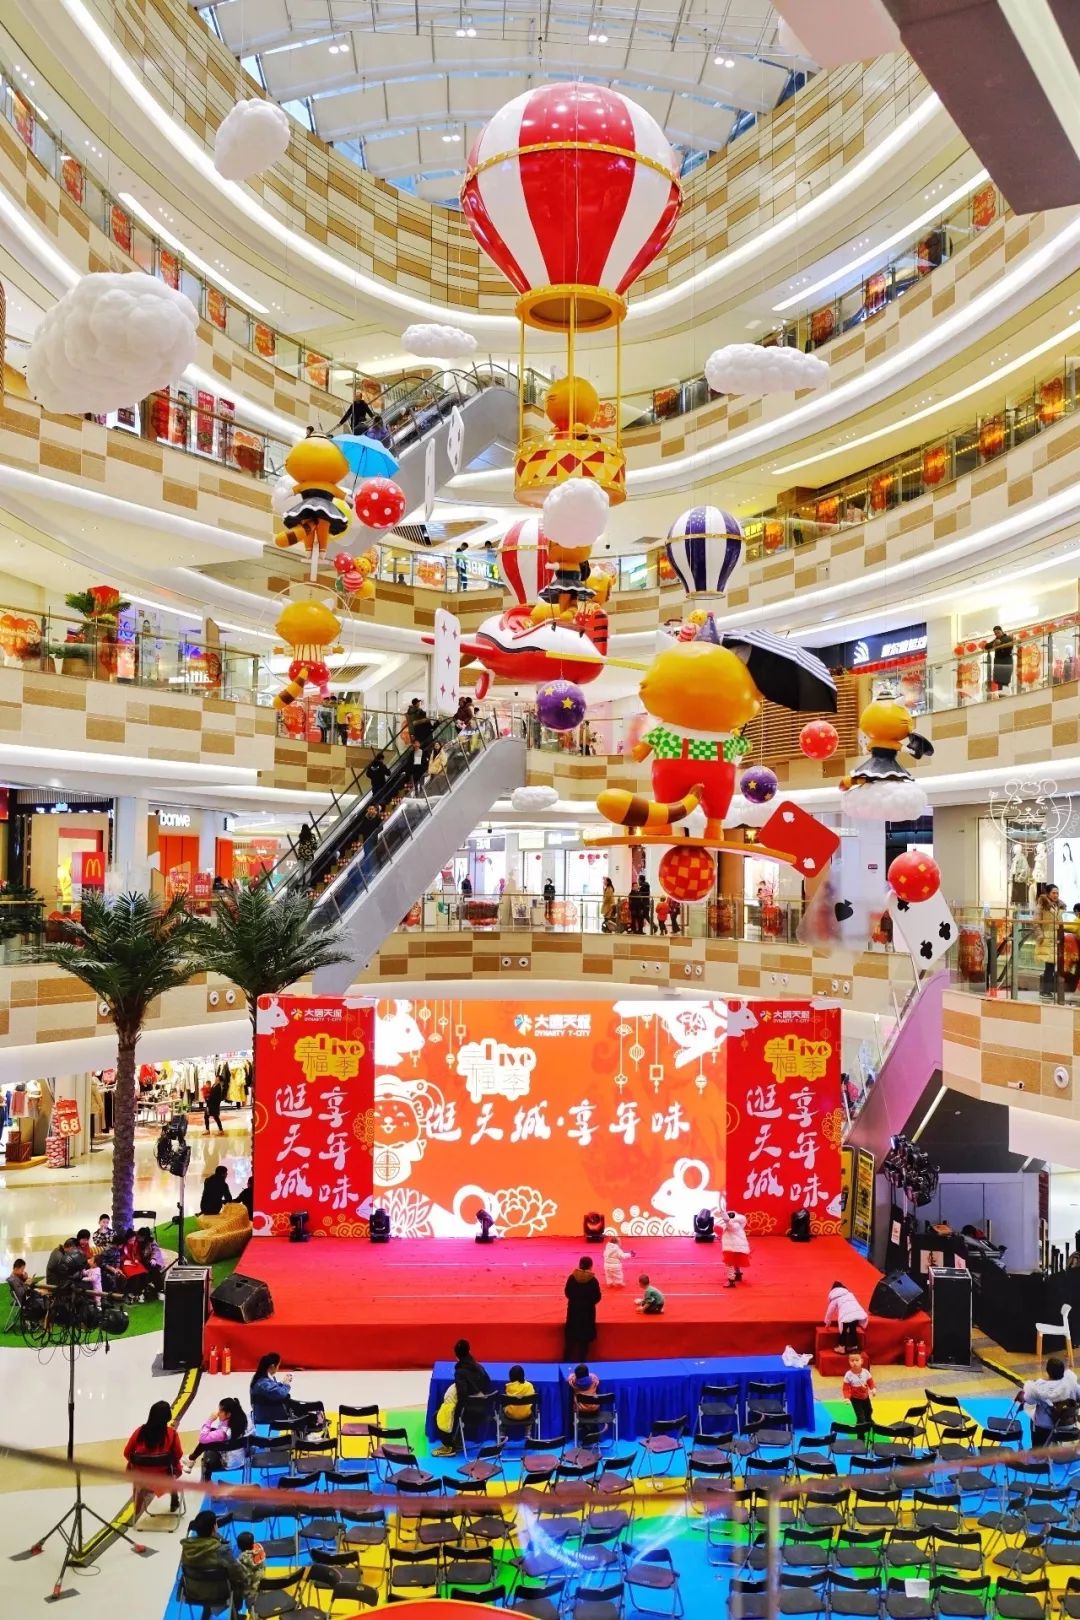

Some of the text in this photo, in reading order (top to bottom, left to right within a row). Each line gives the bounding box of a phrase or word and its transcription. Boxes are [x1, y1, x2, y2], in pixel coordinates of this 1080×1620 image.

[271, 1083, 313, 1200] 逛天城
[318, 1086, 359, 1210] 享年味
[743, 1084, 784, 1200] 逛天城
[788, 1086, 829, 1208] 享年味
